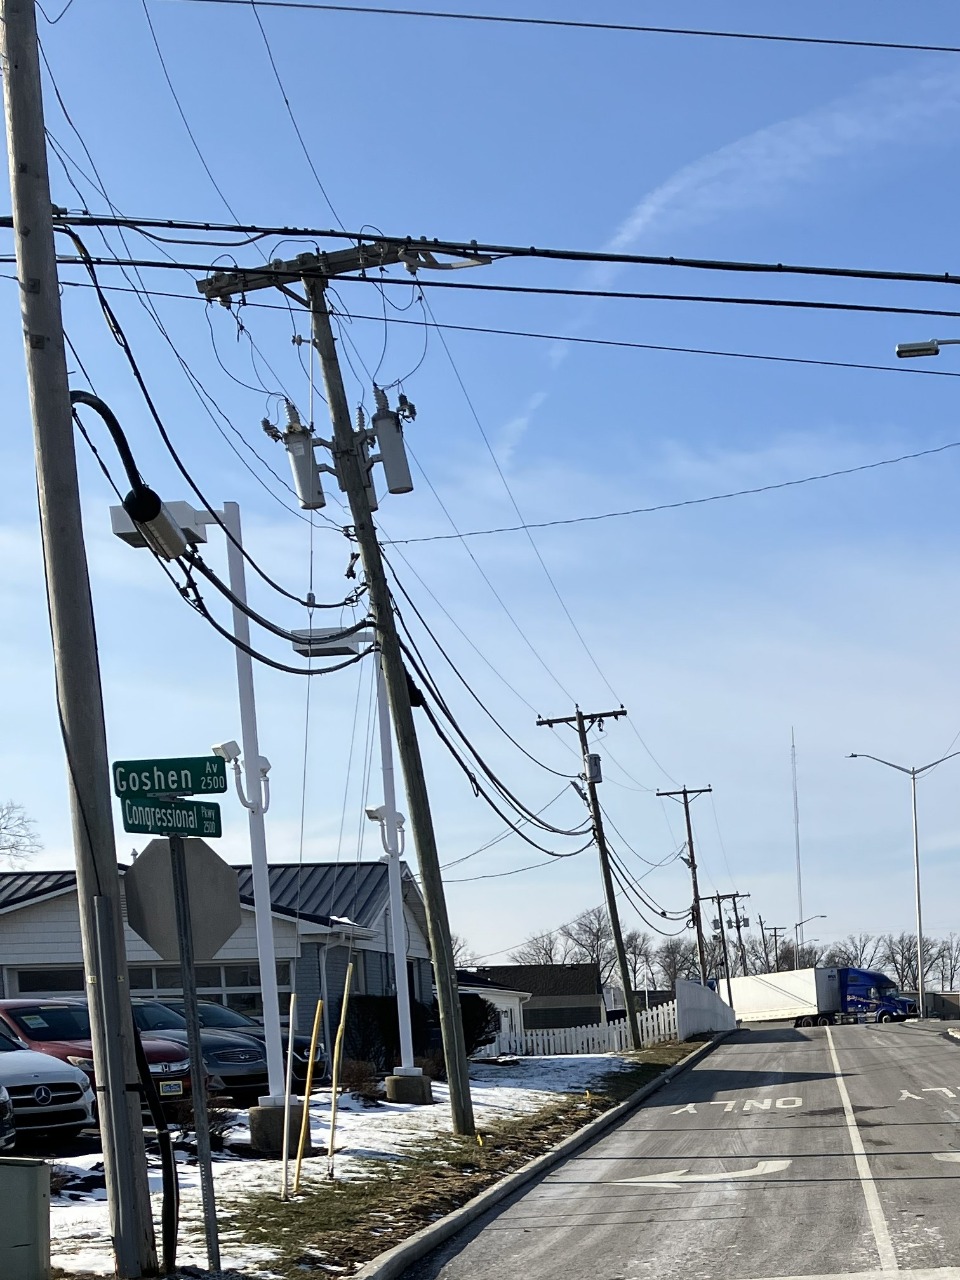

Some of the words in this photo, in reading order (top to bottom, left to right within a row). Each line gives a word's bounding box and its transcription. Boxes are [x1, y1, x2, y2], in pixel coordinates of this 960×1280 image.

[205, 761, 218, 774] Av
[115, 766, 192, 792] Goshen
[200, 776, 225, 789] 2500
[125, 799, 198, 831] Congressional
[201, 806, 215, 820] Pkwy
[669, 1097, 803, 1115] ONLY
